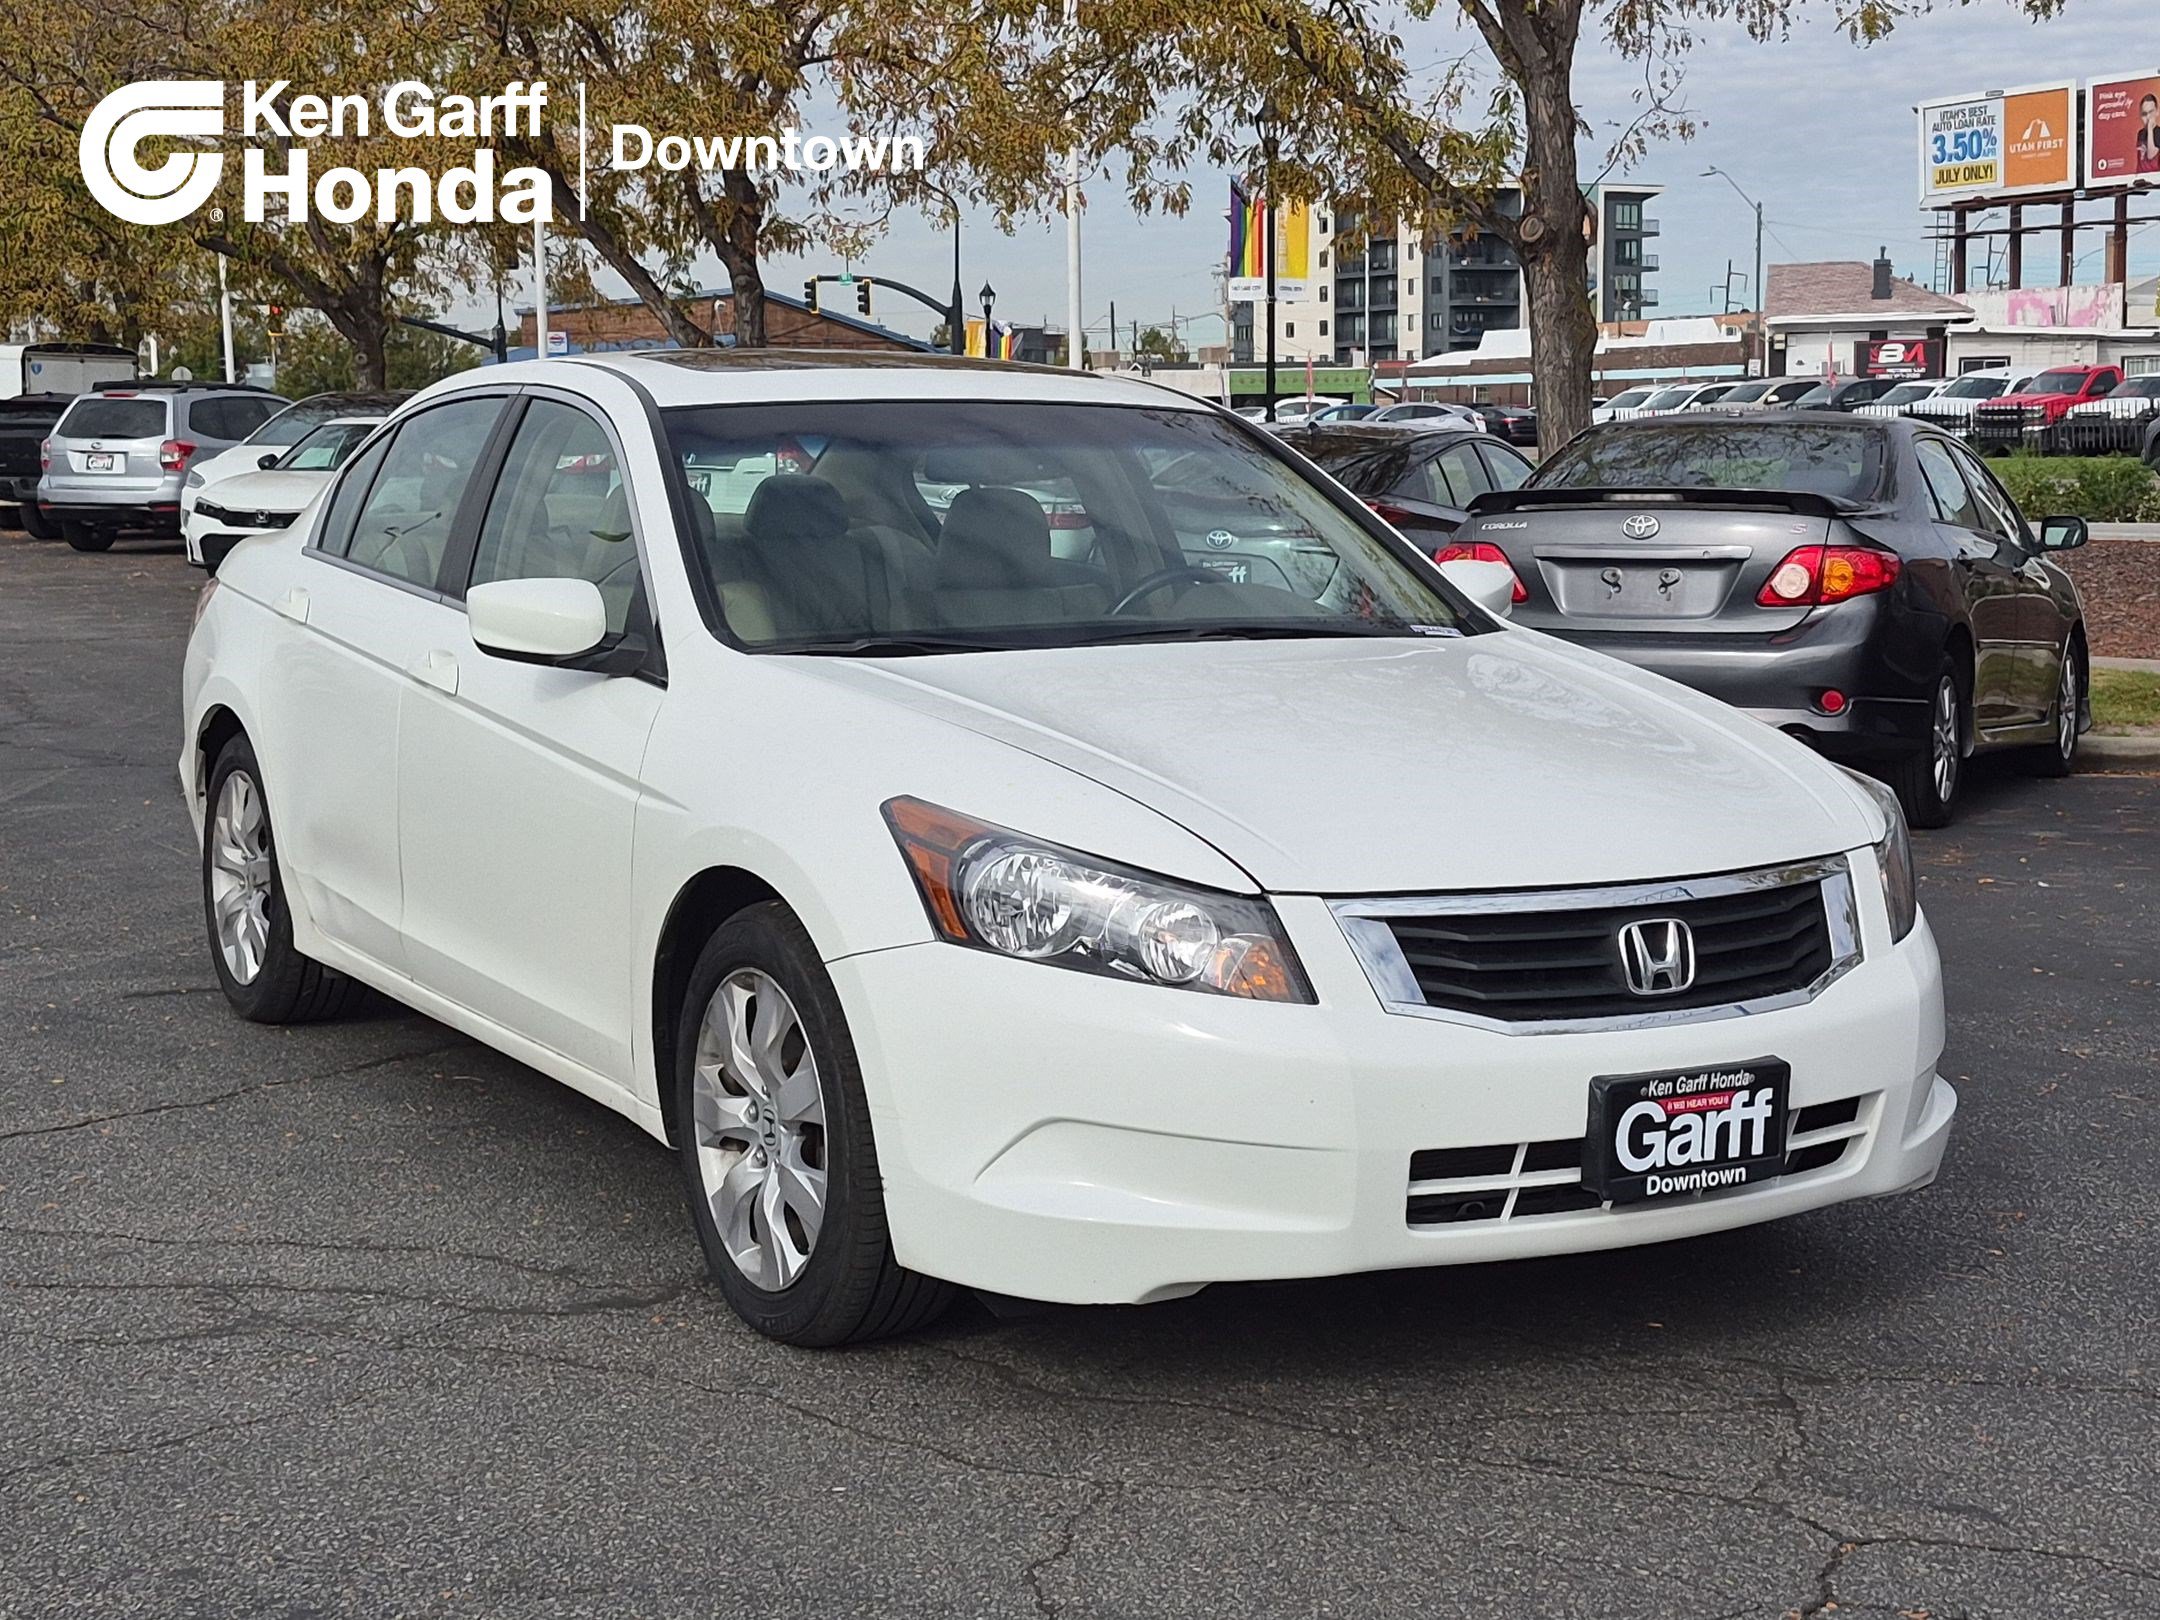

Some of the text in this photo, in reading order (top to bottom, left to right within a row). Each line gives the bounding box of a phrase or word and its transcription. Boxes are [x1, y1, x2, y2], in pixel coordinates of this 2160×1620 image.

[1939, 105, 1988, 121] UTAH'S BEST
[1932, 115, 1996, 132] AUTO LOAN RATE
[2009, 138, 2064, 154] UTAH FIRST
[1935, 163, 1993, 185] JULY ONLY!
[1481, 521, 1528, 531] COROLLA
[1789, 523, 1808, 534] S
[1648, 1069, 1750, 1098] Ken Garff Honda
[1687, 1098, 1707, 1109] HEAR
[1708, 1096, 1723, 1106] YOU
[1615, 1087, 1774, 1173] Garff
[1646, 1165, 1747, 1196] Downtown
